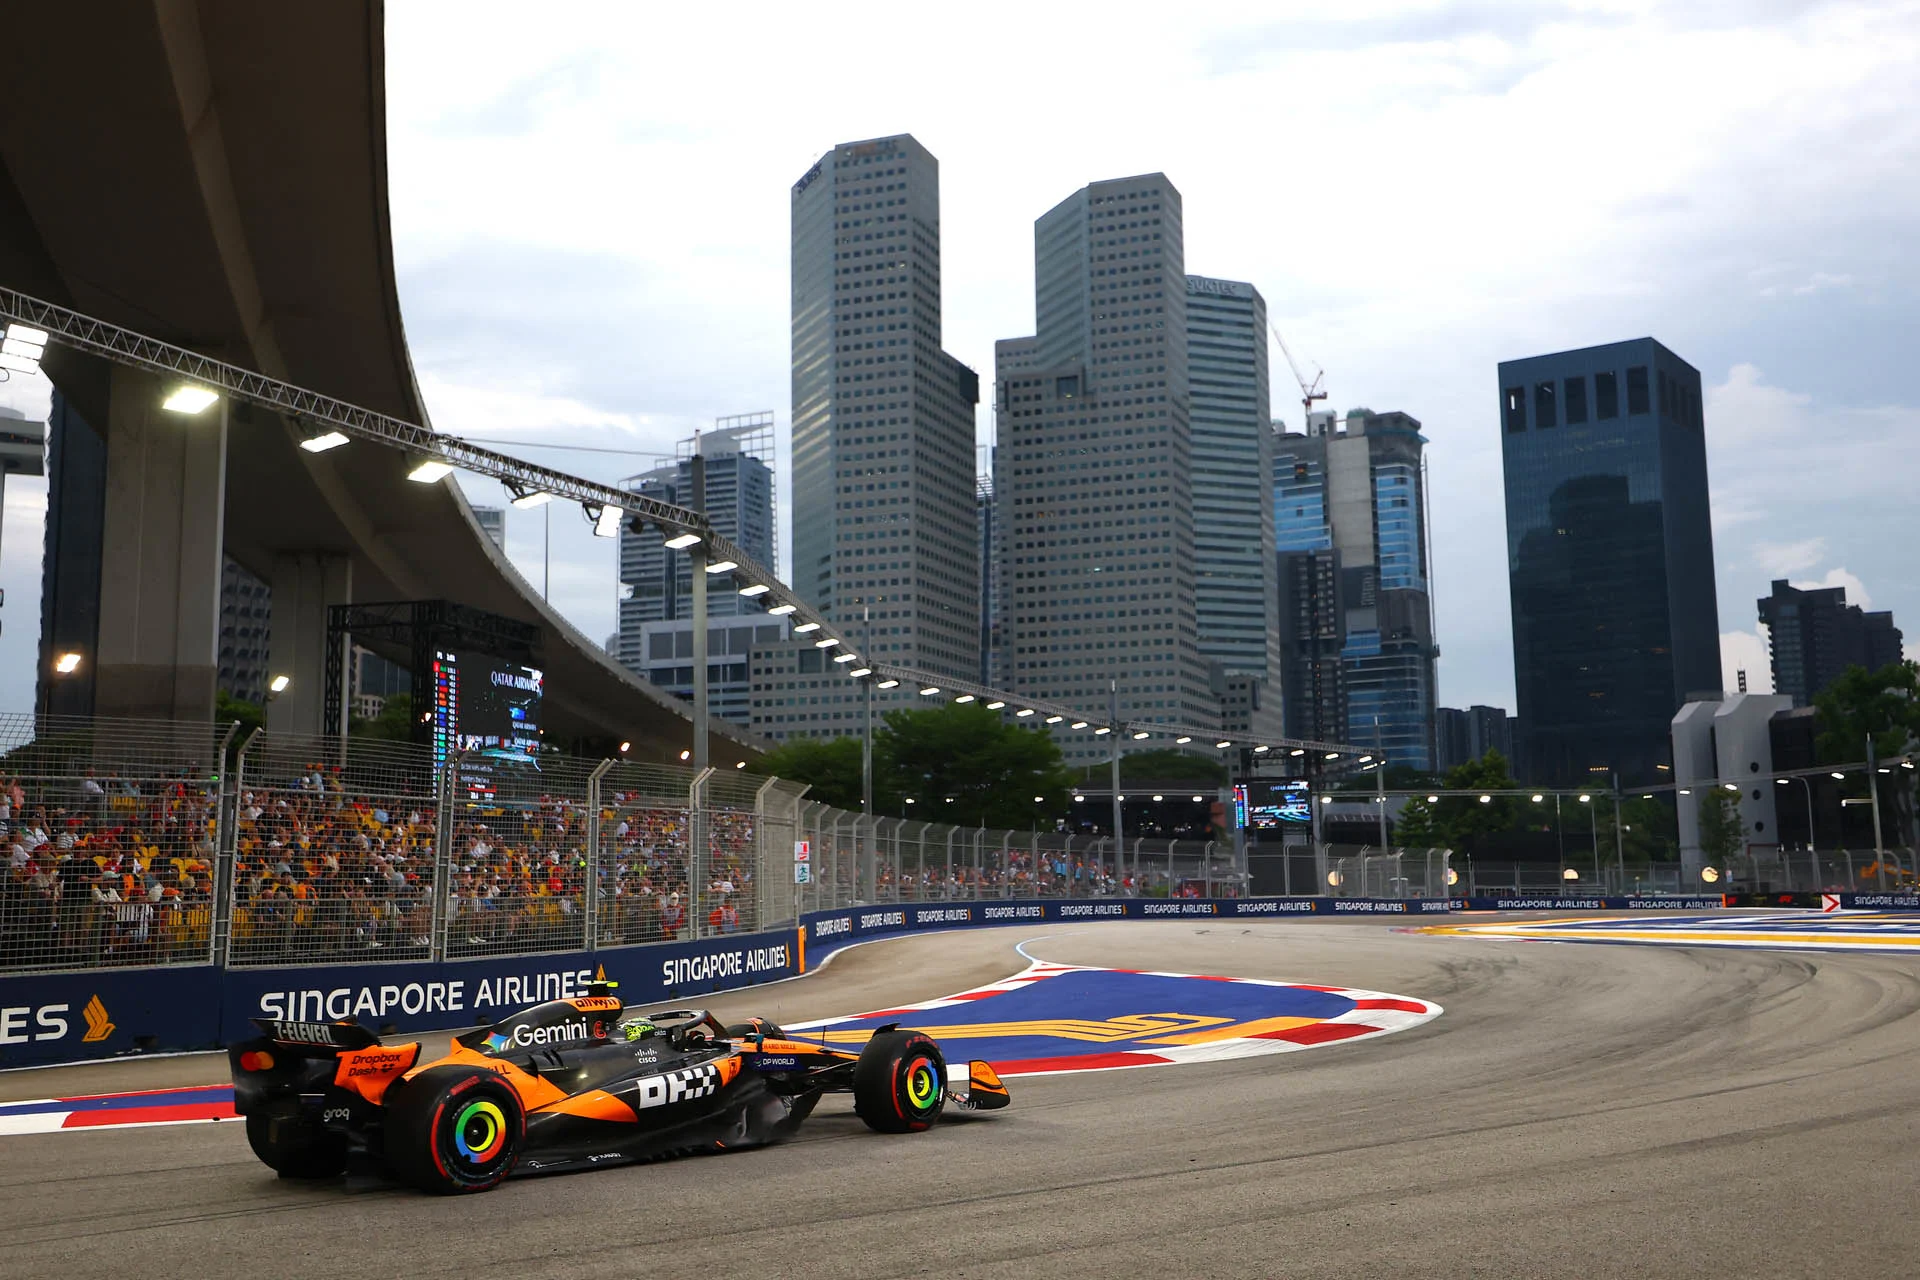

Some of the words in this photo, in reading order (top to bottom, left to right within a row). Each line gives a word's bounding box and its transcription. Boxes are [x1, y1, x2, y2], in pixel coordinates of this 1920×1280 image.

[491, 670, 514, 687] QATAR
[514, 675, 540, 693] AIRWAYS
[1237, 902, 1277, 912] SINGAPORE
[1279, 901, 1311, 911] AIRLINES
[1497, 899, 1552, 909] SINGAPORE
[1555, 899, 1599, 909] AIRLINES
[1628, 900, 1682, 909] SINGAPORE
[1685, 901, 1723, 909] AIRLINES
[1855, 896, 1892, 905] SINGAPORE
[985, 907, 1014, 918] SINGAPORE
[1016, 906, 1041, 917] AIRLINES
[1060, 905, 1093, 916] SINGAPORE
[1095, 904, 1122, 915] AIRLINES
[1144, 904, 1180, 914] SINGAPORE
[1182, 903, 1212, 914] AIRLINES
[1335, 902, 1372, 911] SINGAPORE
[1374, 902, 1403, 912] AIRLINES
[861, 912, 883, 929] SINGAPORE
[883, 911, 902, 926] AIRLINES
[917, 909, 944, 923] SINGAPORE
[945, 908, 968, 921] AIRLINES
[663, 951, 743, 986] SINGAPORE
[746, 945, 785, 972] AIRLINES
[260, 981, 465, 1022] SINGAPORE
[474, 969, 592, 1009] AIRLINES
[575, 998, 617, 1009] allwyn
[0, 1003, 69, 1045] ES
[273, 1021, 335, 1044] 7-ELEVEN
[513, 1016, 588, 1047] Gemini
[351, 1053, 402, 1066] Dropbox
[348, 1067, 378, 1077] Dash
[323, 1108, 350, 1122] groq
